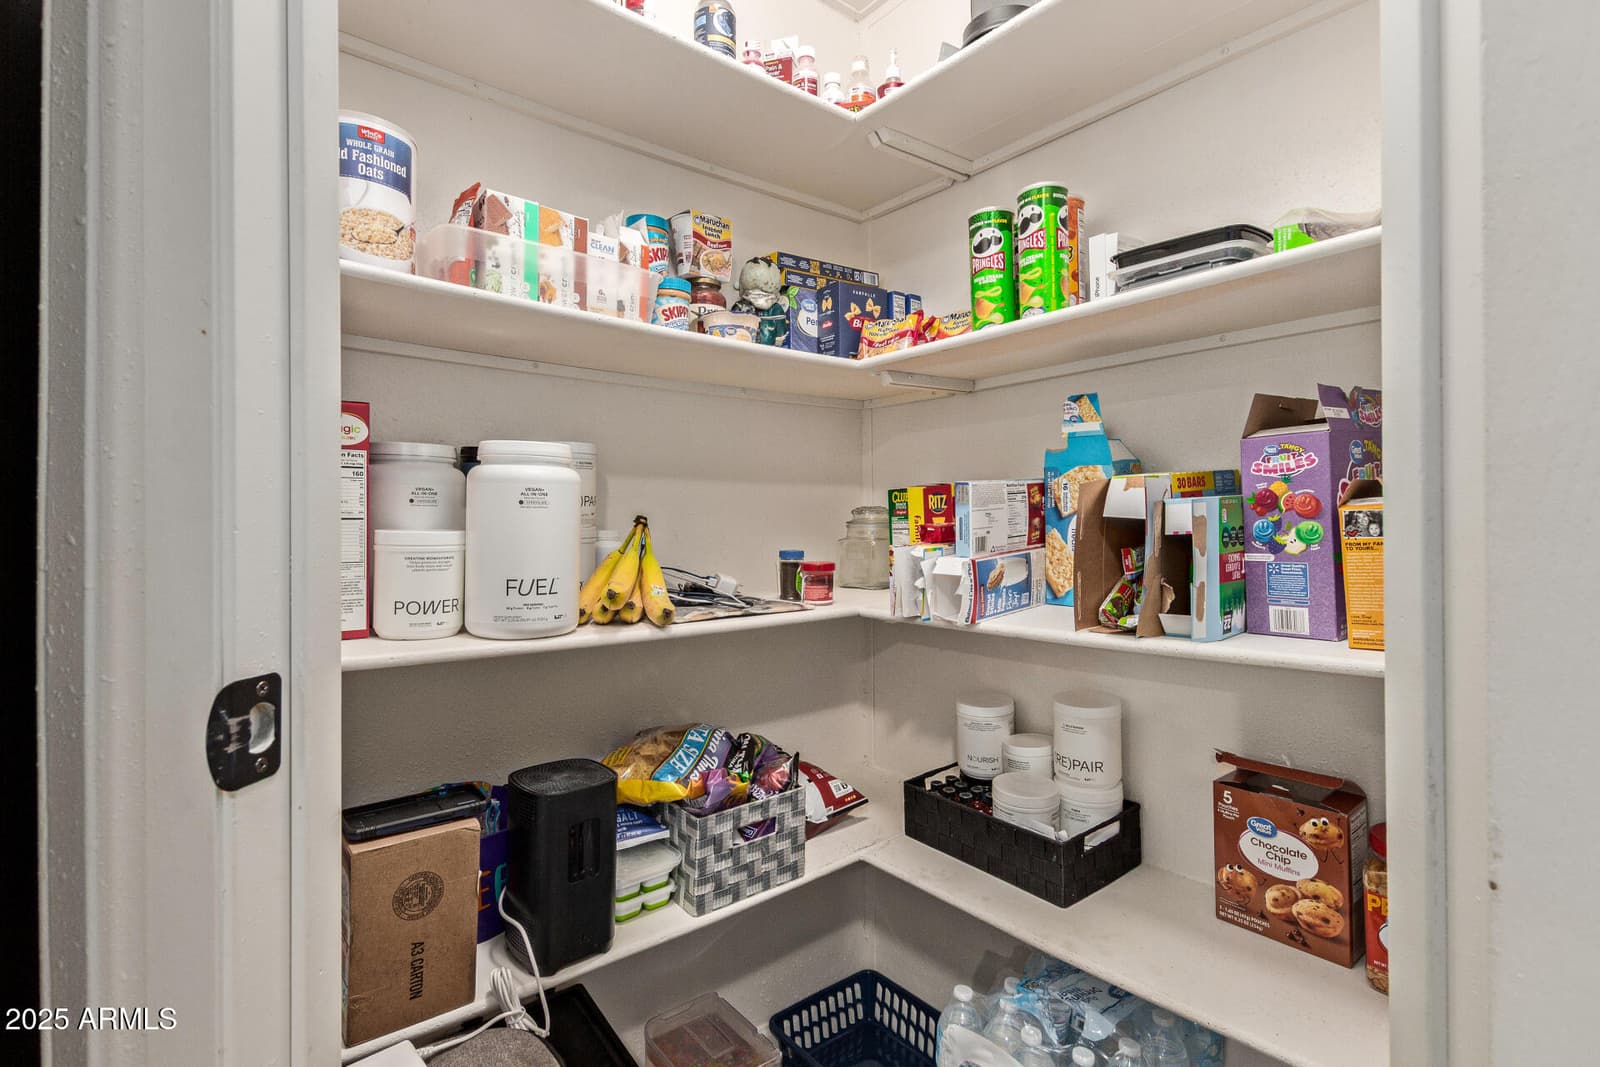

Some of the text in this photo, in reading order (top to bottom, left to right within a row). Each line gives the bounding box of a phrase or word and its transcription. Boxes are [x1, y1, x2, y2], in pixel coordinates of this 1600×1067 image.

[345, 138, 395, 158] WHOLE GRAIN
[351, 149, 407, 178] Fashioned
[358, 163, 384, 180] Oats
[699, 215, 730, 230] Maruchan
[590, 241, 615, 255] CLEAN
[973, 252, 1005, 273] PRINGLES
[1280, 442, 1305, 453] TANGY
[1252, 454, 1317, 474] SMILES
[1266, 452, 1297, 464] FRUIT
[1177, 475, 1206, 489] 30 BARS
[928, 495, 948, 510] RITZ
[506, 577, 559, 597] FUEL
[394, 598, 460, 616] POWER
[671, 743, 699, 774] SIZE
[967, 753, 999, 764] NOURISH
[1223, 790, 1233, 804] 5
[1250, 819, 1272, 831] Great
[1250, 837, 1308, 860] Chocolate
[1257, 858, 1301, 876] Mini Muffins
[1265, 851, 1291, 866] Chip
[410, 941, 425, 1001] A3 CARTON
